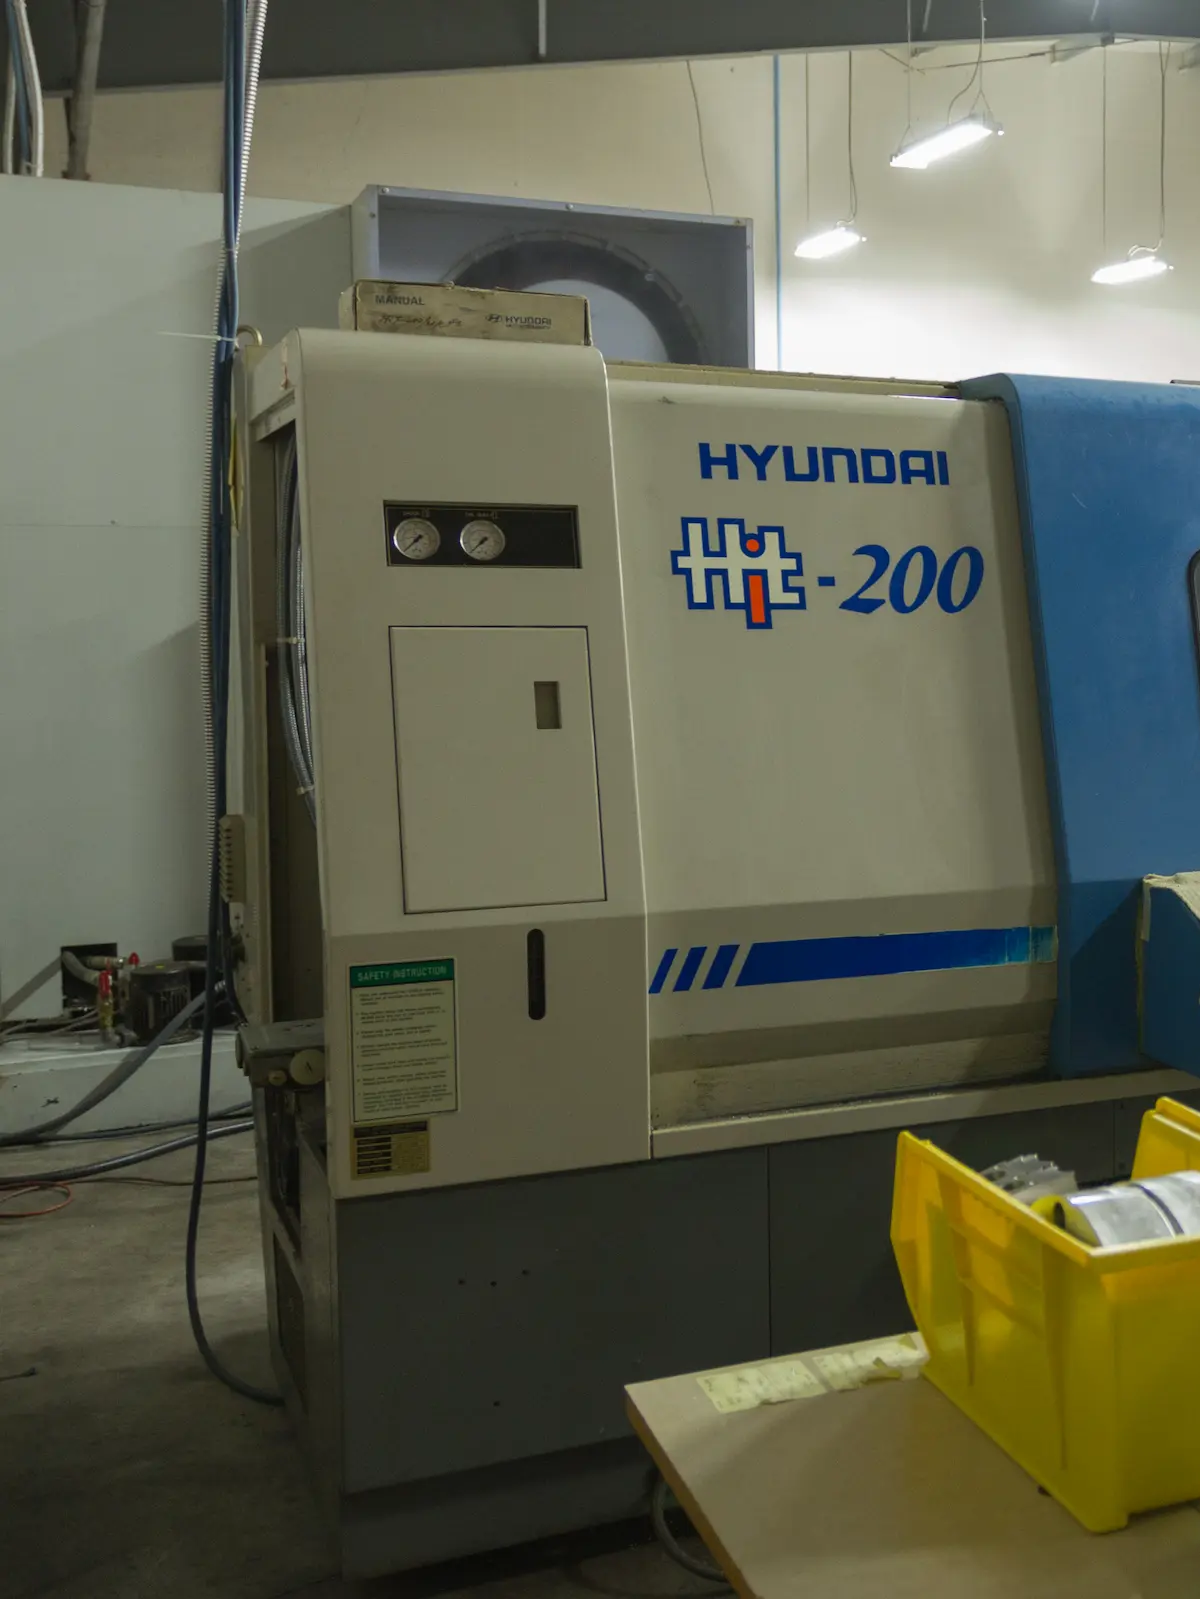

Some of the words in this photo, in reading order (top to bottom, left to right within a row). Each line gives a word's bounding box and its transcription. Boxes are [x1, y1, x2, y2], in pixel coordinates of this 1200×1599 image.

[375, 294, 425, 306] MANUAL
[505, 315, 552, 325] HYUNDAI
[698, 442, 950, 485] HYUNDAI
[357, 970, 390, 982] SAFETY
[392, 965, 447, 979] INSTRUCTION
